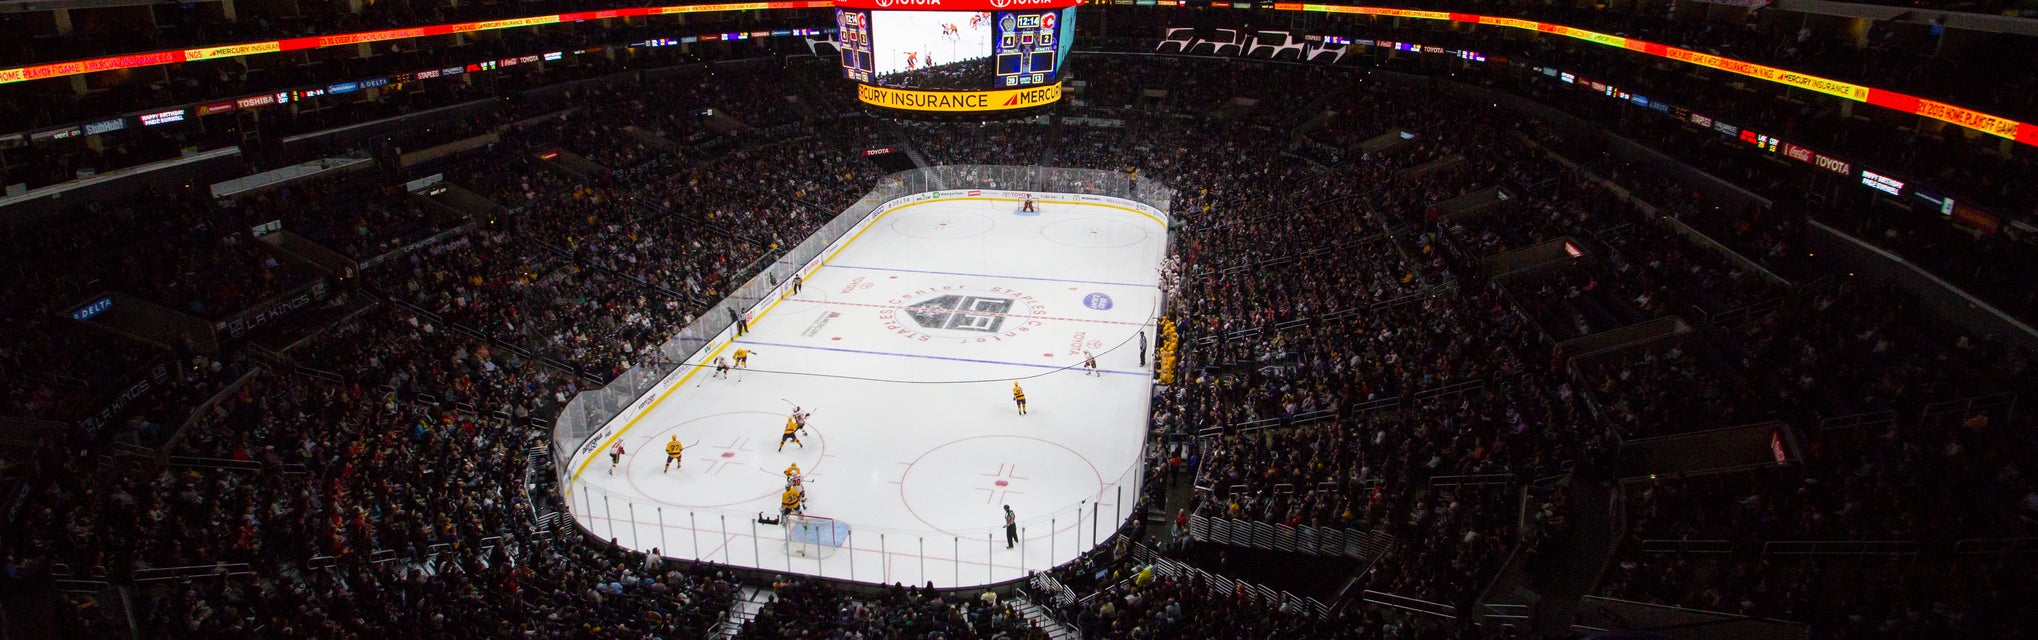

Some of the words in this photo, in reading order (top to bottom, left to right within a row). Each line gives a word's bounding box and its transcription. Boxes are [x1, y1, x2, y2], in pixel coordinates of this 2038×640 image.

[1019, 16, 1039, 26] 12:14
[1006, 37, 1011, 45] 4
[1044, 35, 1049, 43] 2
[216, 43, 250, 57] MERCURY
[1423, 46, 1444, 54] TOYOTA
[519, 55, 539, 64] TOYOTA
[23, 65, 57, 80] PLAYOFF
[59, 62, 81, 75] GAME
[417, 70, 440, 80] STAPLES
[366, 79, 388, 89] DELTA
[1783, 74, 1812, 87] MERCURY
[1811, 78, 1849, 95] INSURANCE
[1854, 87, 1867, 99] WIN
[237, 96, 274, 108] TOSHIBA
[892, 94, 988, 107] INSURANCE
[86, 118, 123, 134] StubHub!
[1964, 111, 1996, 131] PLAYOFF
[867, 148, 889, 156] TOYOTA
[1814, 154, 1850, 176] TOYOTA
[892, 198, 910, 208] DELTA
[269, 294, 310, 320] KINGS
[991, 286, 1046, 316] STAPLES
[81, 298, 112, 319] DELTA
[1068, 331, 1086, 356] TOYOTA
[112, 379, 150, 412] KINGS
